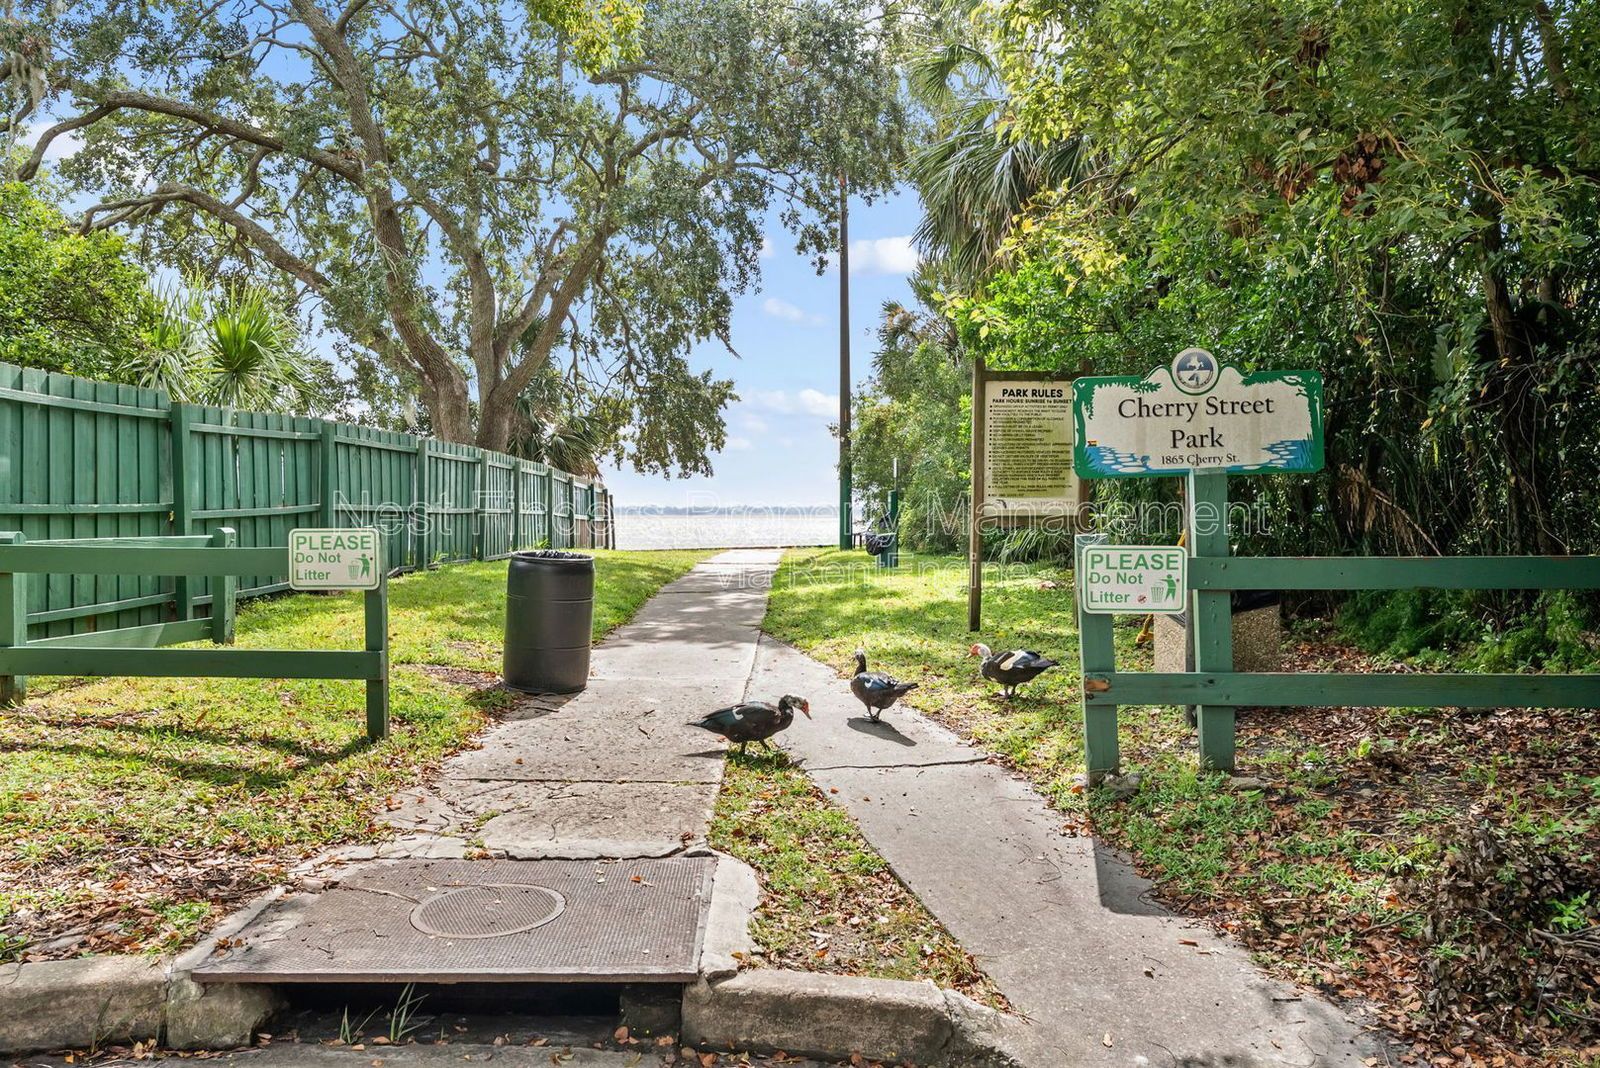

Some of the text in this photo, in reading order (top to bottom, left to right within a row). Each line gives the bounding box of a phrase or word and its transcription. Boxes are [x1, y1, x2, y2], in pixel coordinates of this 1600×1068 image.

[1002, 389, 1063, 397] PARK RULES
[1118, 396, 1274, 423] Cherry Street
[1170, 427, 1224, 449] Park
[1161, 453, 1240, 466] 1865 Cherry St.
[296, 535, 372, 550] PLEASE
[295, 552, 341, 563] Do Not
[1090, 553, 1179, 570] PLEASE
[296, 569, 331, 580] Litter
[1090, 572, 1144, 584] Do Not
[1090, 591, 1130, 603] Litter
